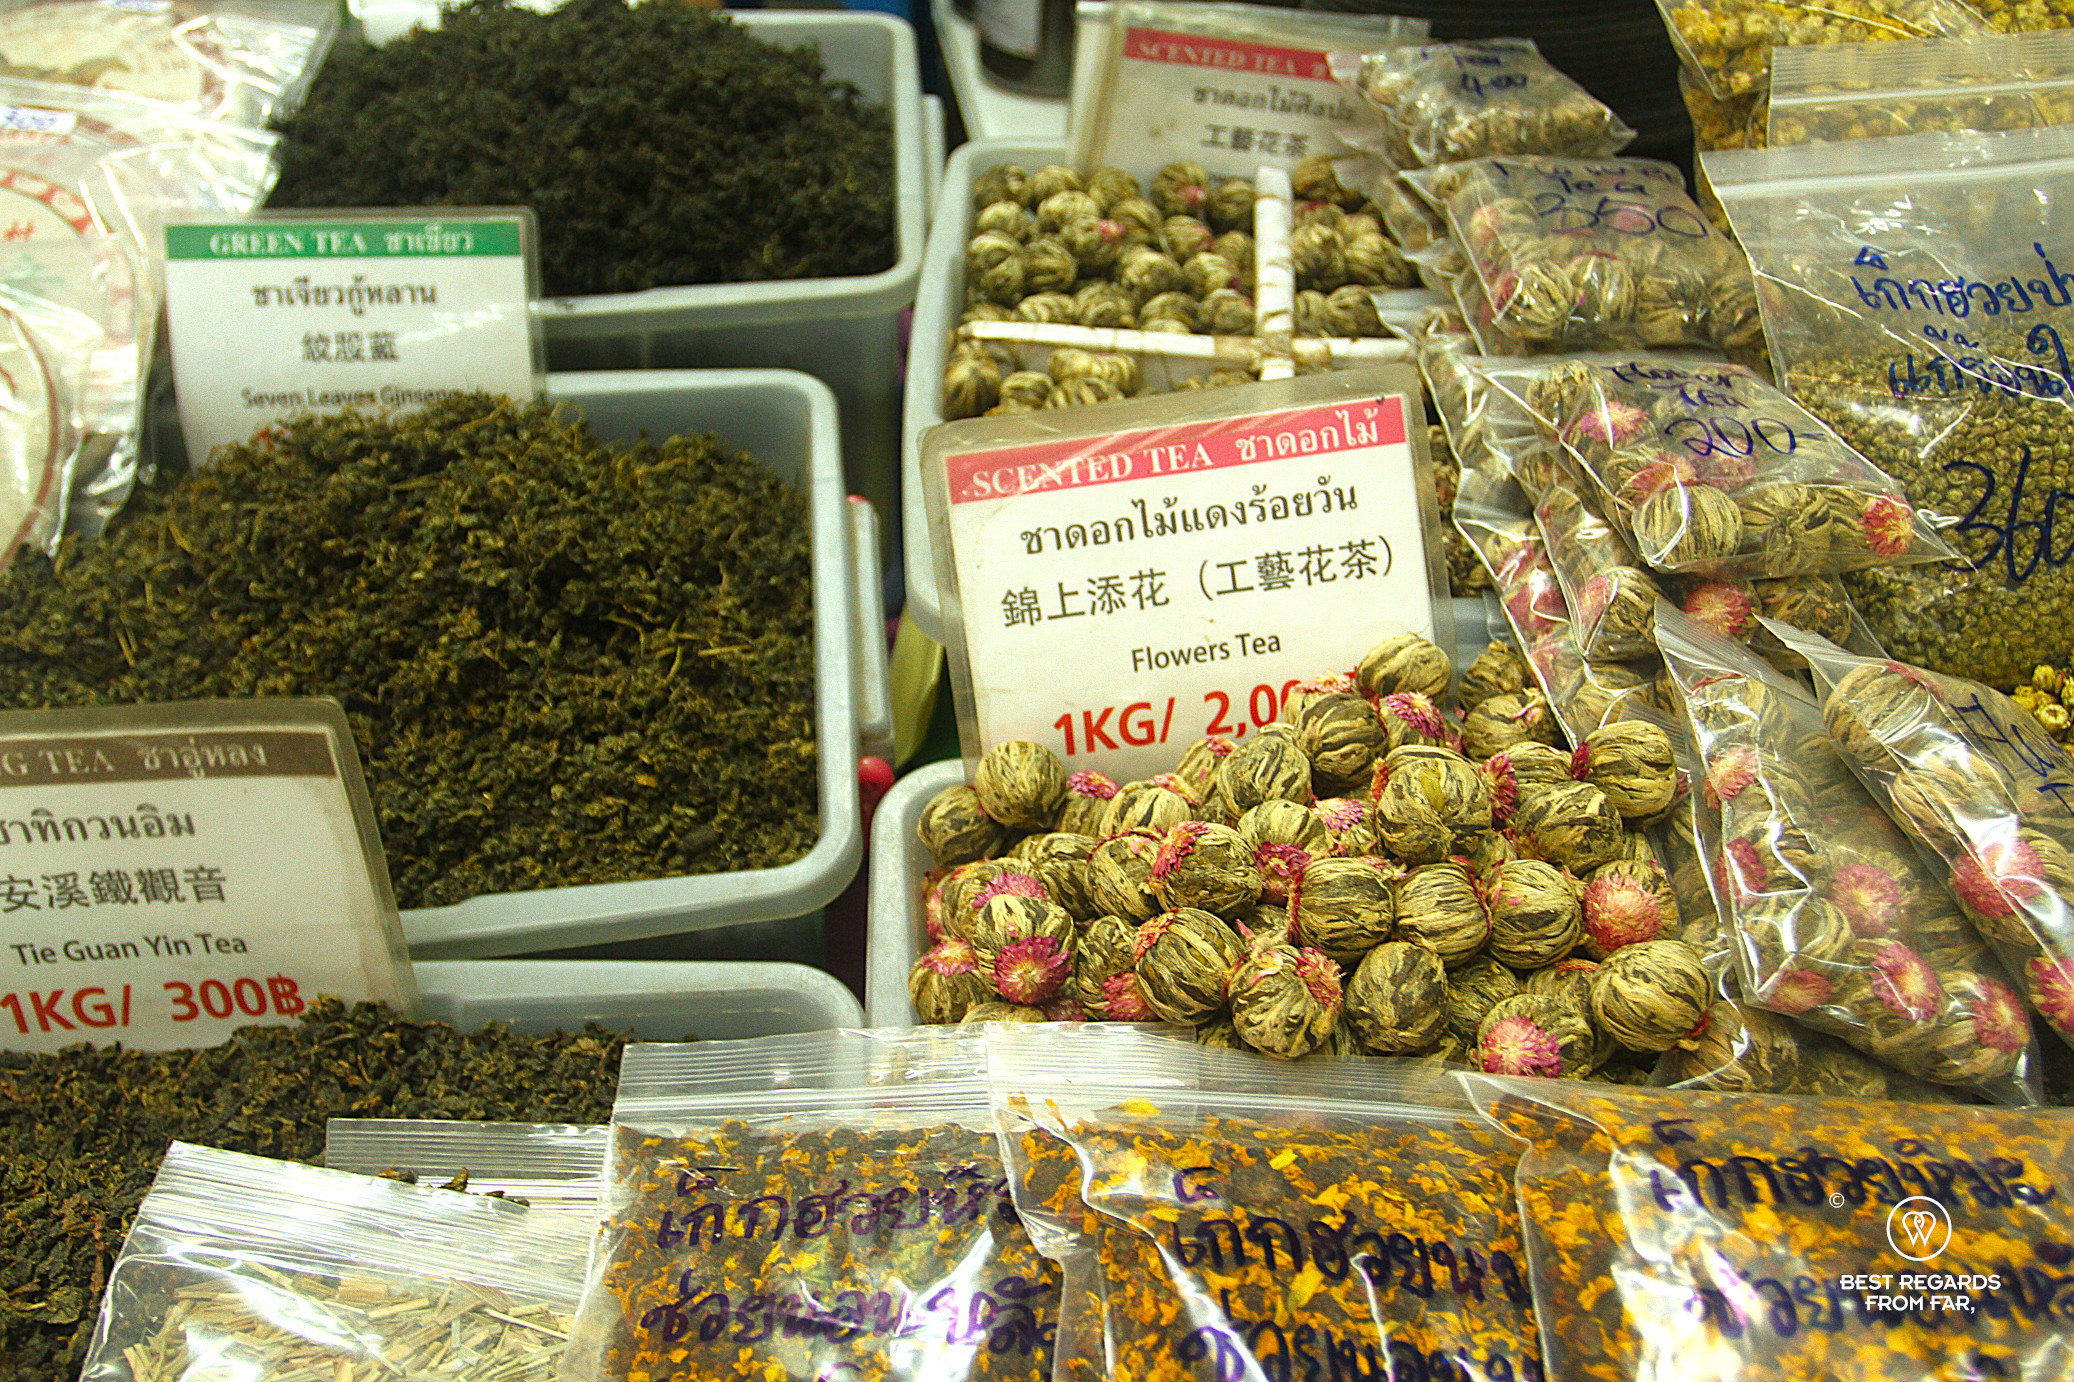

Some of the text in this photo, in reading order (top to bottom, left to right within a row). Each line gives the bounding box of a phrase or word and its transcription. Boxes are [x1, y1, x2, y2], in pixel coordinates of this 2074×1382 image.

[1139, 41, 1247, 66] SCENTED
[1255, 52, 1295, 74] TEA
[209, 224, 474, 255] GREEN TEA ชาเขียว
[241, 387, 301, 408] Seven
[307, 386, 376, 407] Leaves
[972, 405, 1380, 498] SCENTED TEA ชาดอกไม้
[1020, 474, 1360, 556] ชาดอกไม้แดงร้อยวัน
[1130, 632, 1283, 674] Flowers Tea
[1053, 697, 1177, 757] 1KG/
[38, 748, 115, 775] TEA
[138, 736, 268, 779] ชาอู่หลง
[11, 932, 248, 966] Tie Guan Yin Tea
[0, 984, 131, 1034] 1KG/
